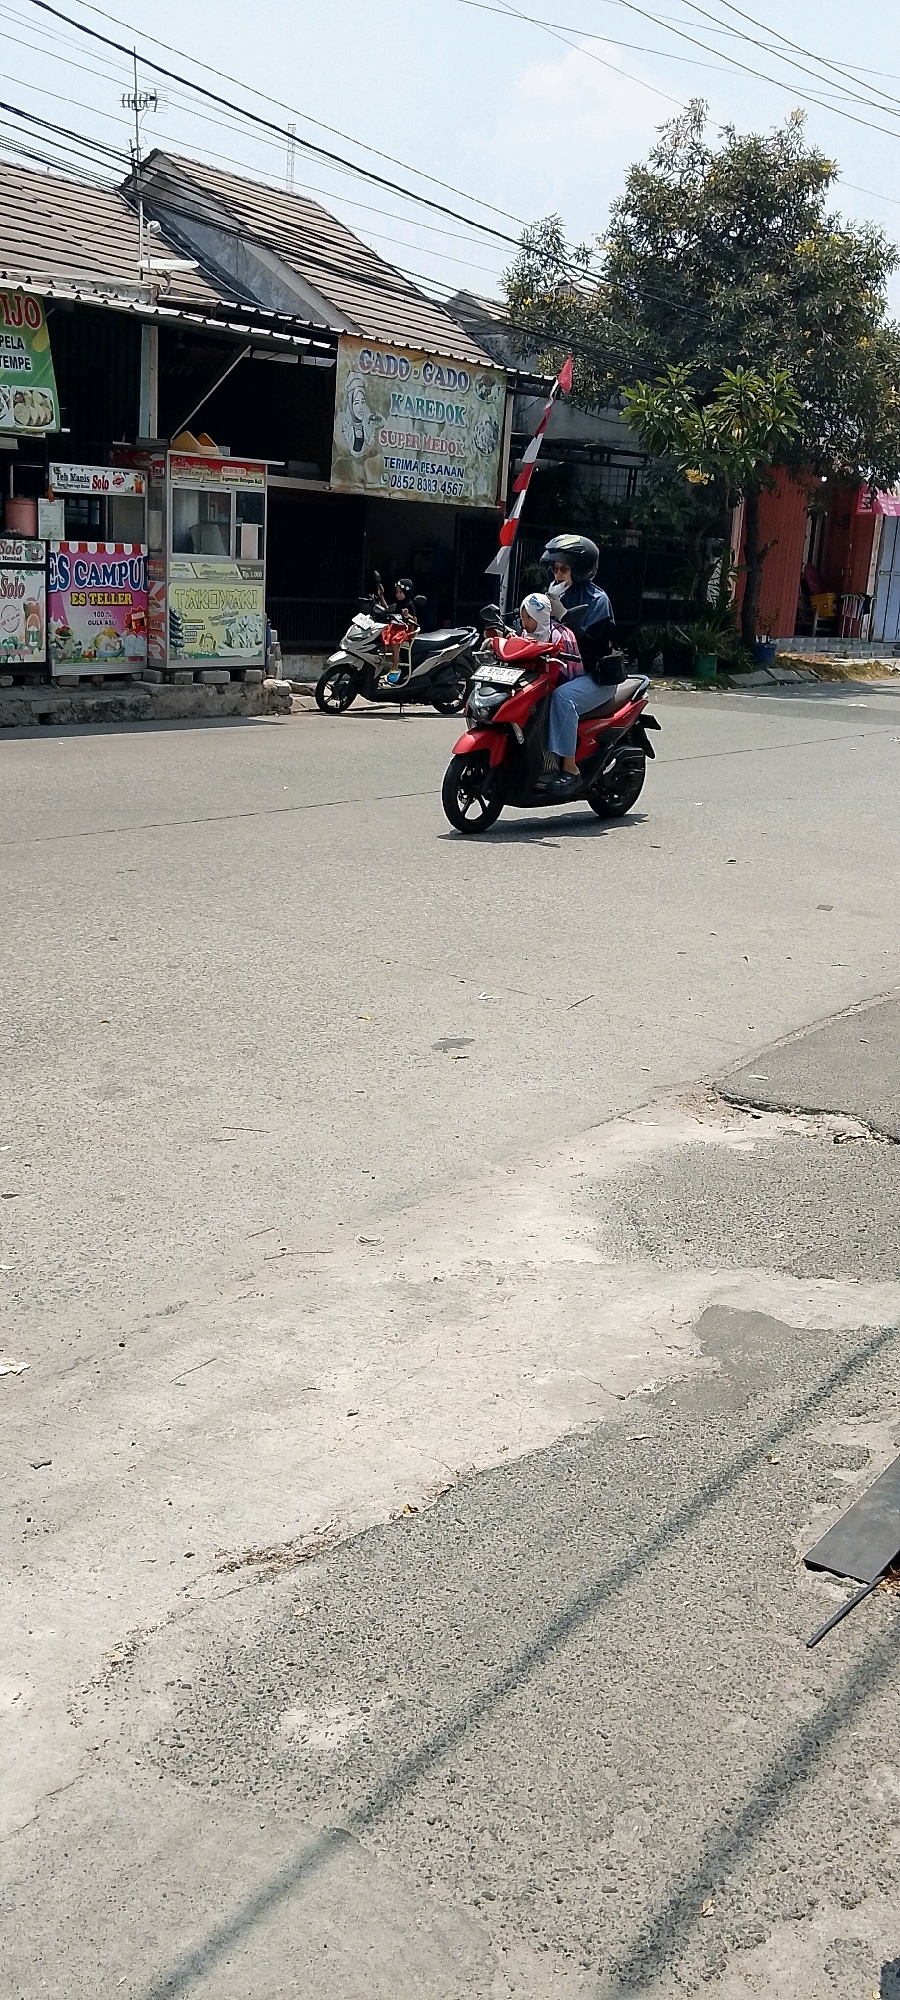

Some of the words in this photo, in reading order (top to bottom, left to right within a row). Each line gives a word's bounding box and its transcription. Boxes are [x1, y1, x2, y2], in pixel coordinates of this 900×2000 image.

[0, 335, 25, 350] PELA
[358, 350, 411, 382] GADO
[422, 361, 470, 394] GADO
[390, 393, 467, 427] KAREDOK
[379, 429, 420, 451] SUPER
[422, 434, 466, 459] MEDOK
[383, 456, 419, 473] TERIMA
[420, 460, 465, 479] PESANAN
[92, 475, 110, 491] Solo
[390, 474, 415, 490] 0852
[439, 480, 464, 497] 4567
[0, 540, 23, 555] Solo
[48, 551, 69, 592] ES
[1, 576, 25, 598] Solo
[70, 592, 86, 606] ES
[88, 593, 133, 606] TELLER
[175, 588, 259, 610] TAKOYAKI
